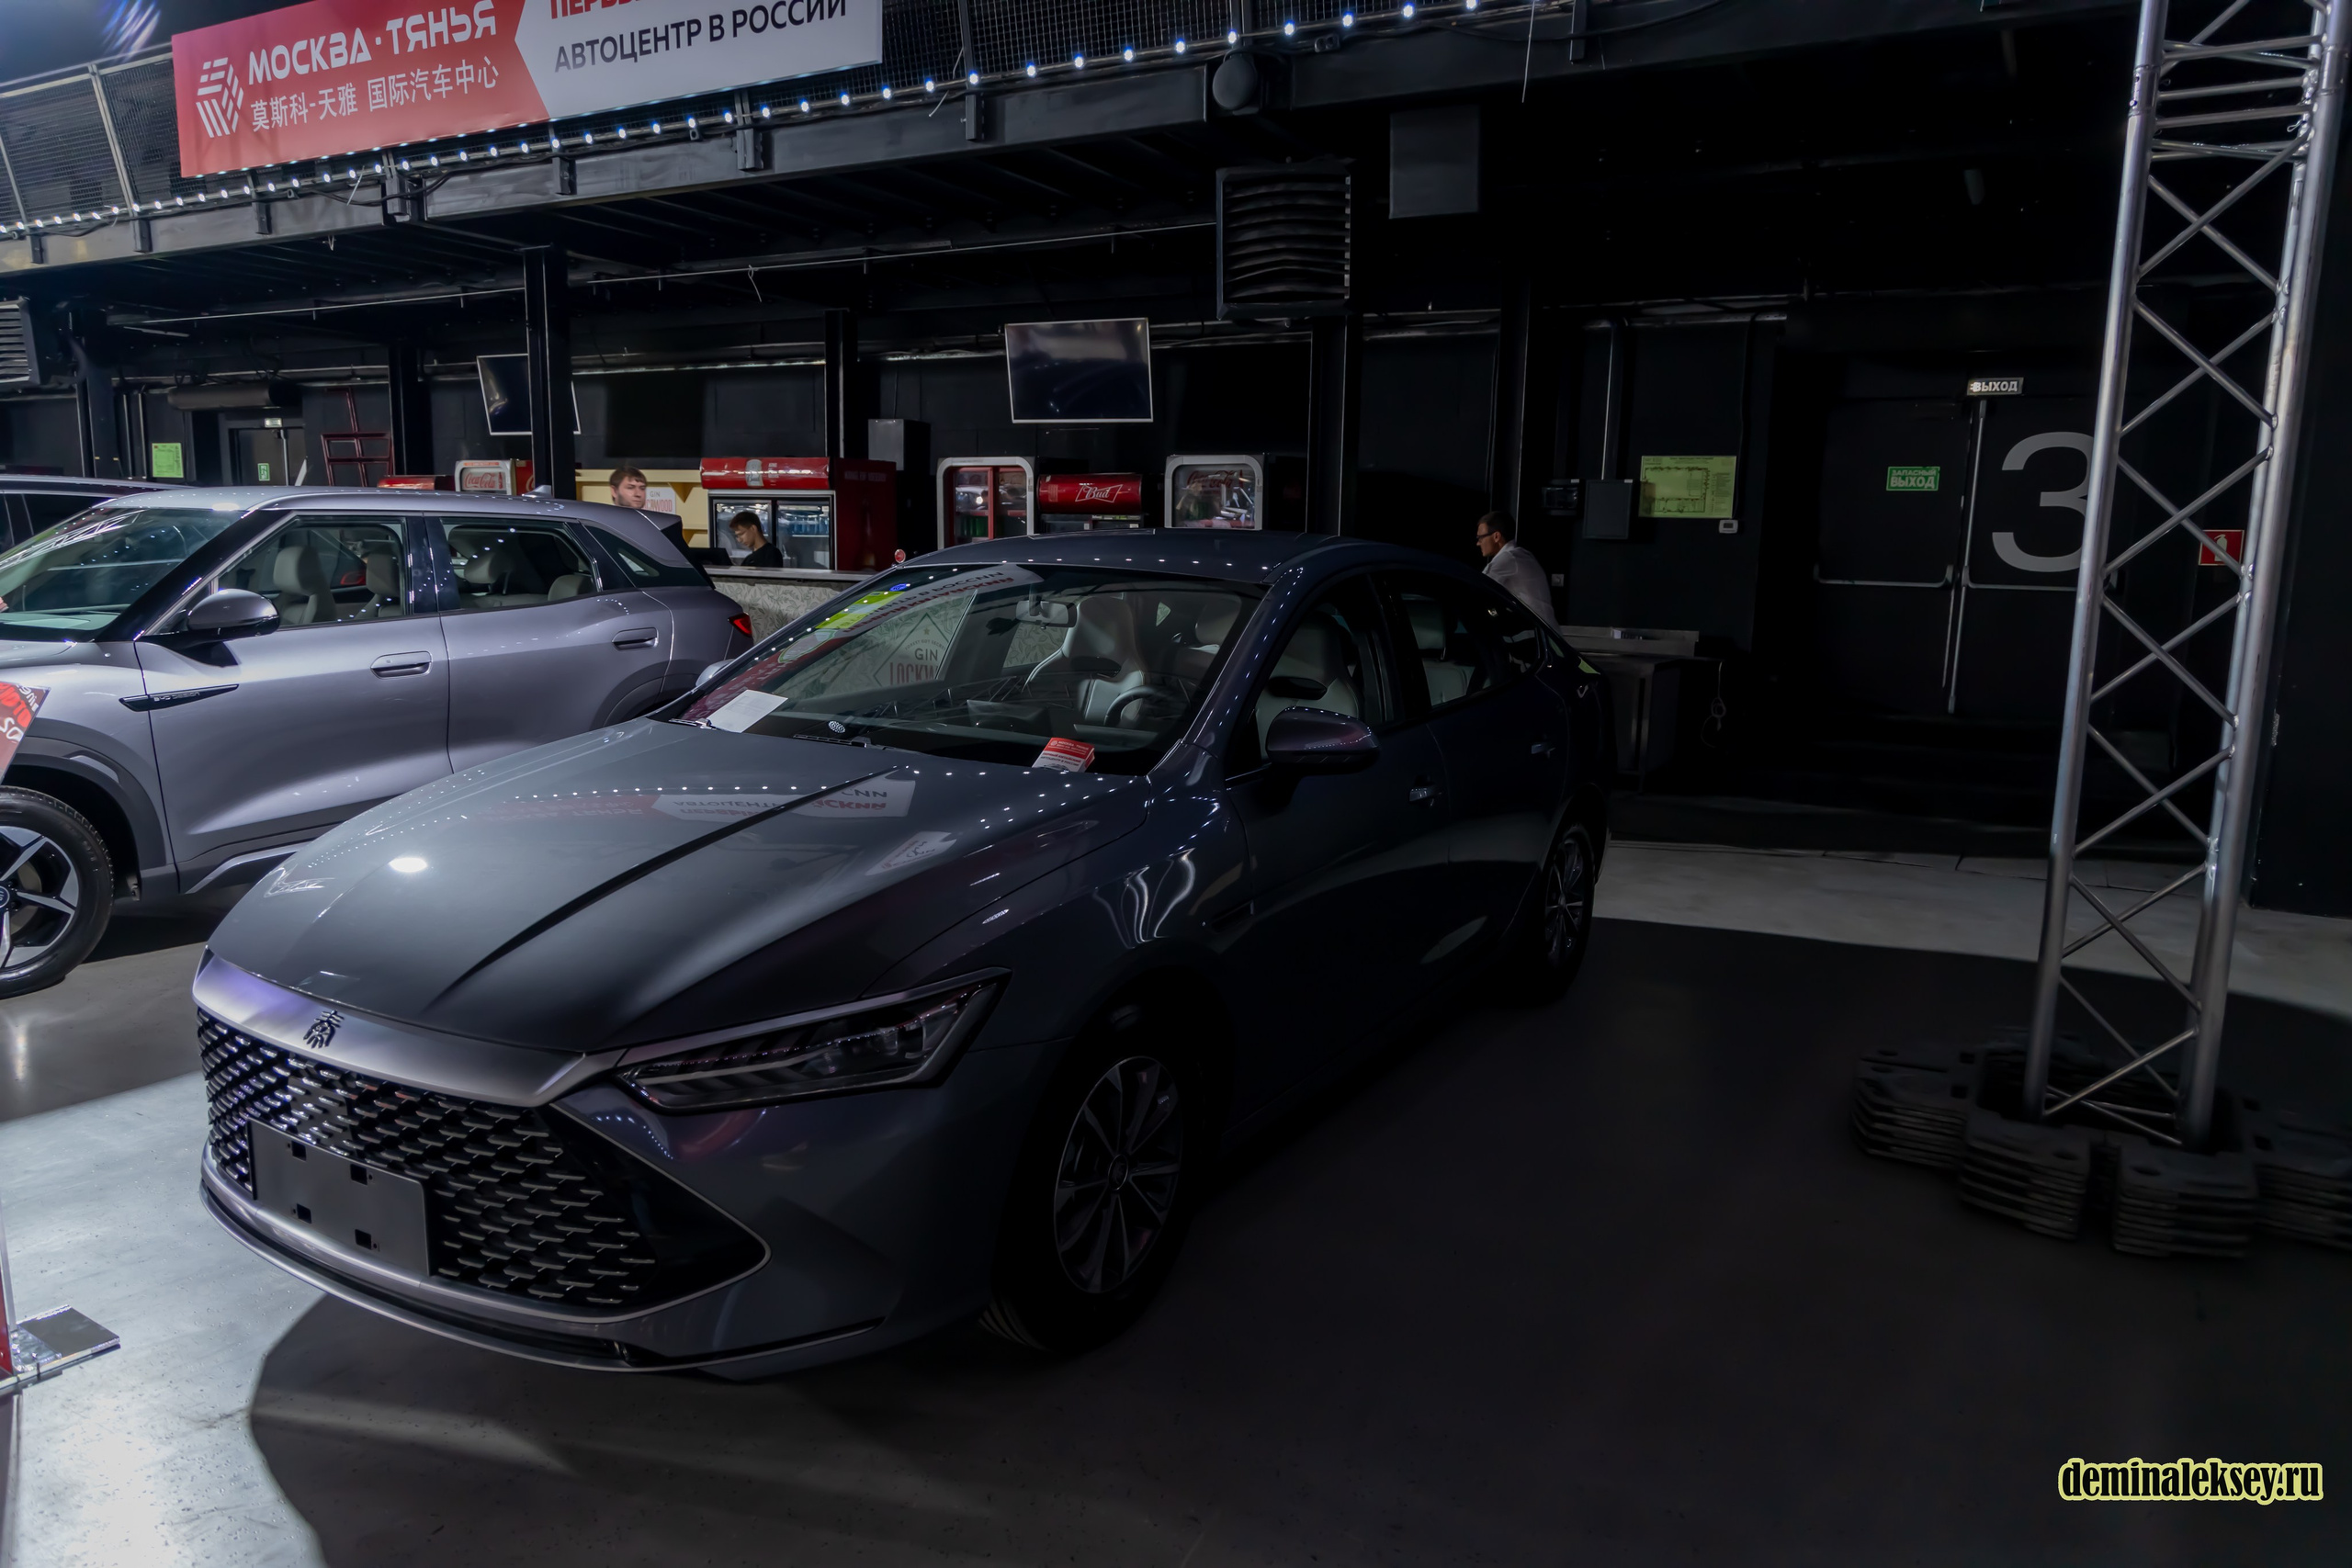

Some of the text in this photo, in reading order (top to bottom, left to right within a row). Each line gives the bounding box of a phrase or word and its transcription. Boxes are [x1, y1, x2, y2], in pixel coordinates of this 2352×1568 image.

[248, 0, 497, 85] МОСКВА ТЯНЬЯ
[555, 0, 847, 73] АВТОЦЕНТР В РОССИИ
[368, 56, 500, 112] 国际汽车中心
[1973, 380, 2018, 392] ВЫХОД
[1083, 486, 1110, 500] Bud
[1890, 476, 1936, 489] ВЫХОД
[1992, 431, 2095, 573] 3
[914, 648, 938, 661] GIN
